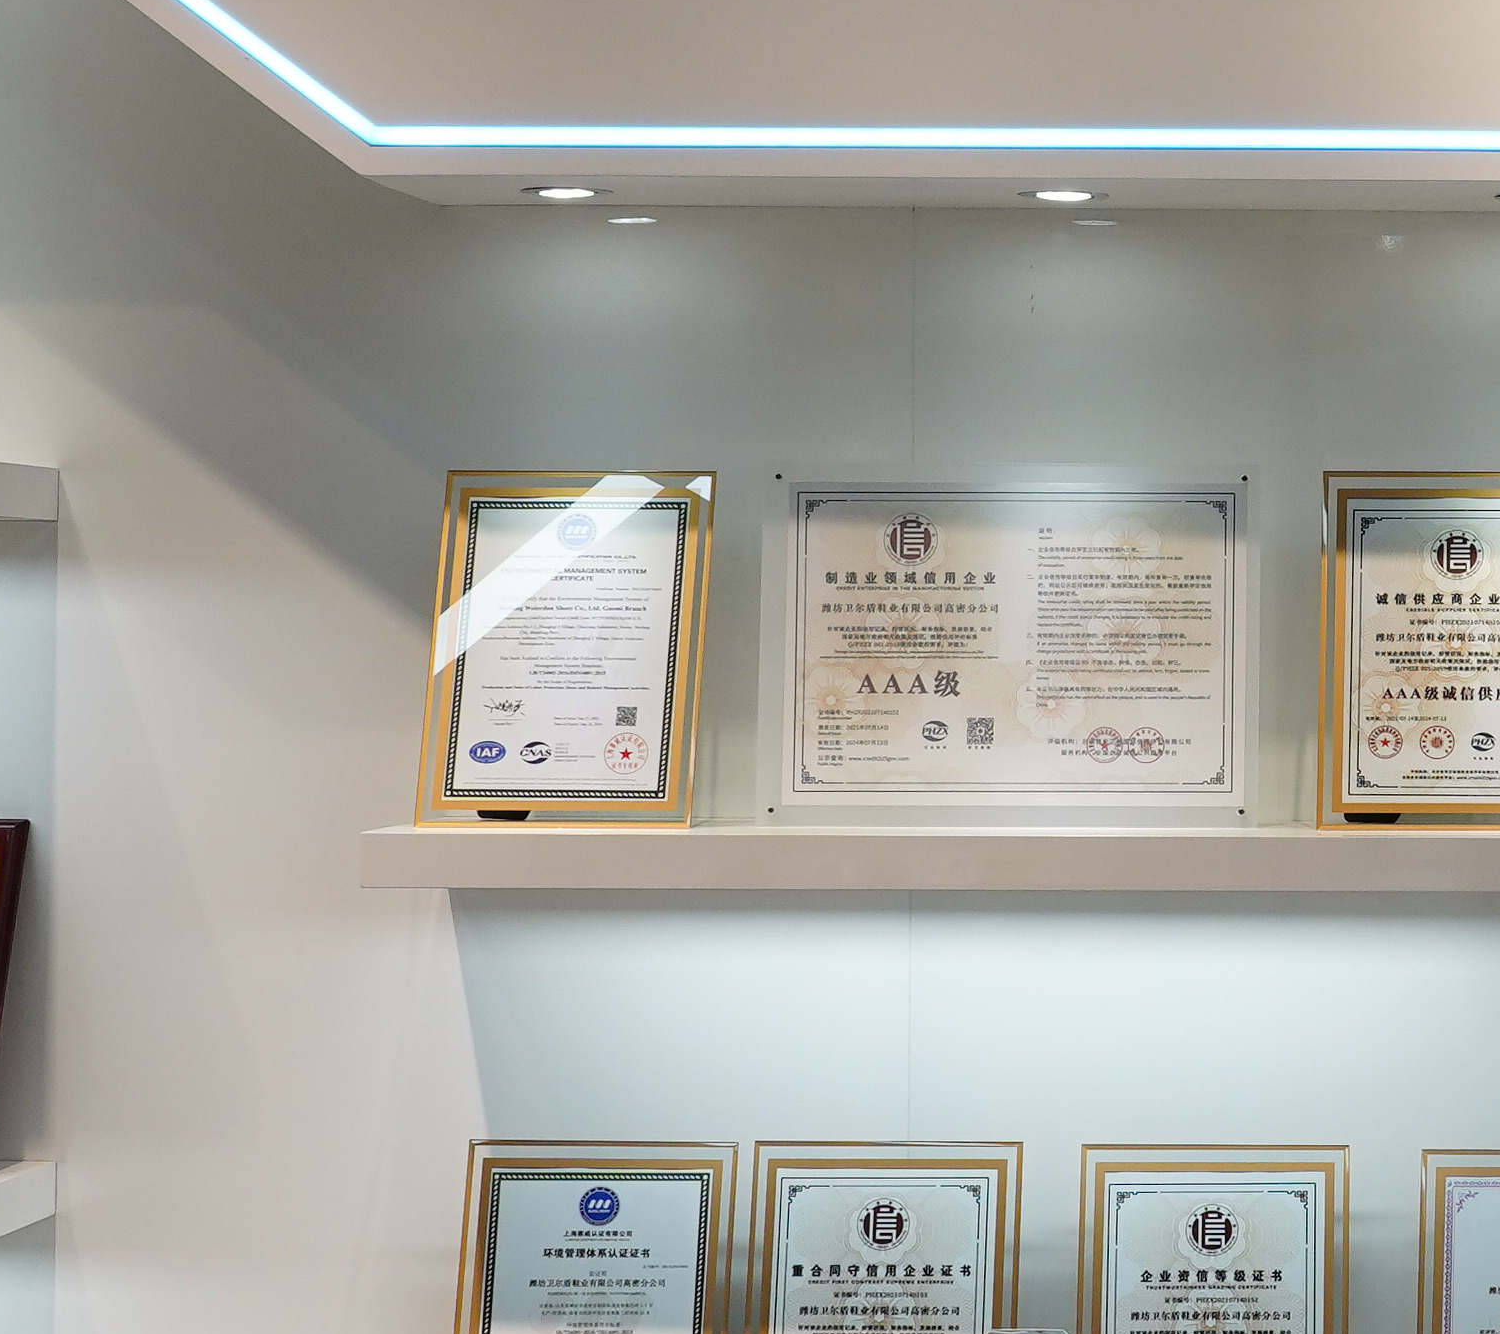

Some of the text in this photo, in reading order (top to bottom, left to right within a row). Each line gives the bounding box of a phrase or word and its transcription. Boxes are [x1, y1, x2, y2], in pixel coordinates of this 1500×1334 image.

[825, 571, 996, 584] 制造业领域信用企业
[856, 670, 960, 698] AAA级
[476, 747, 500, 758] IAF
[520, 747, 552, 758] CNAS
[543, 1248, 650, 1259] 环境管理体系认证证书
[792, 1264, 972, 1277] 重合同守信用企业证书
[1140, 1270, 1283, 1283] 企业资信等级证书
